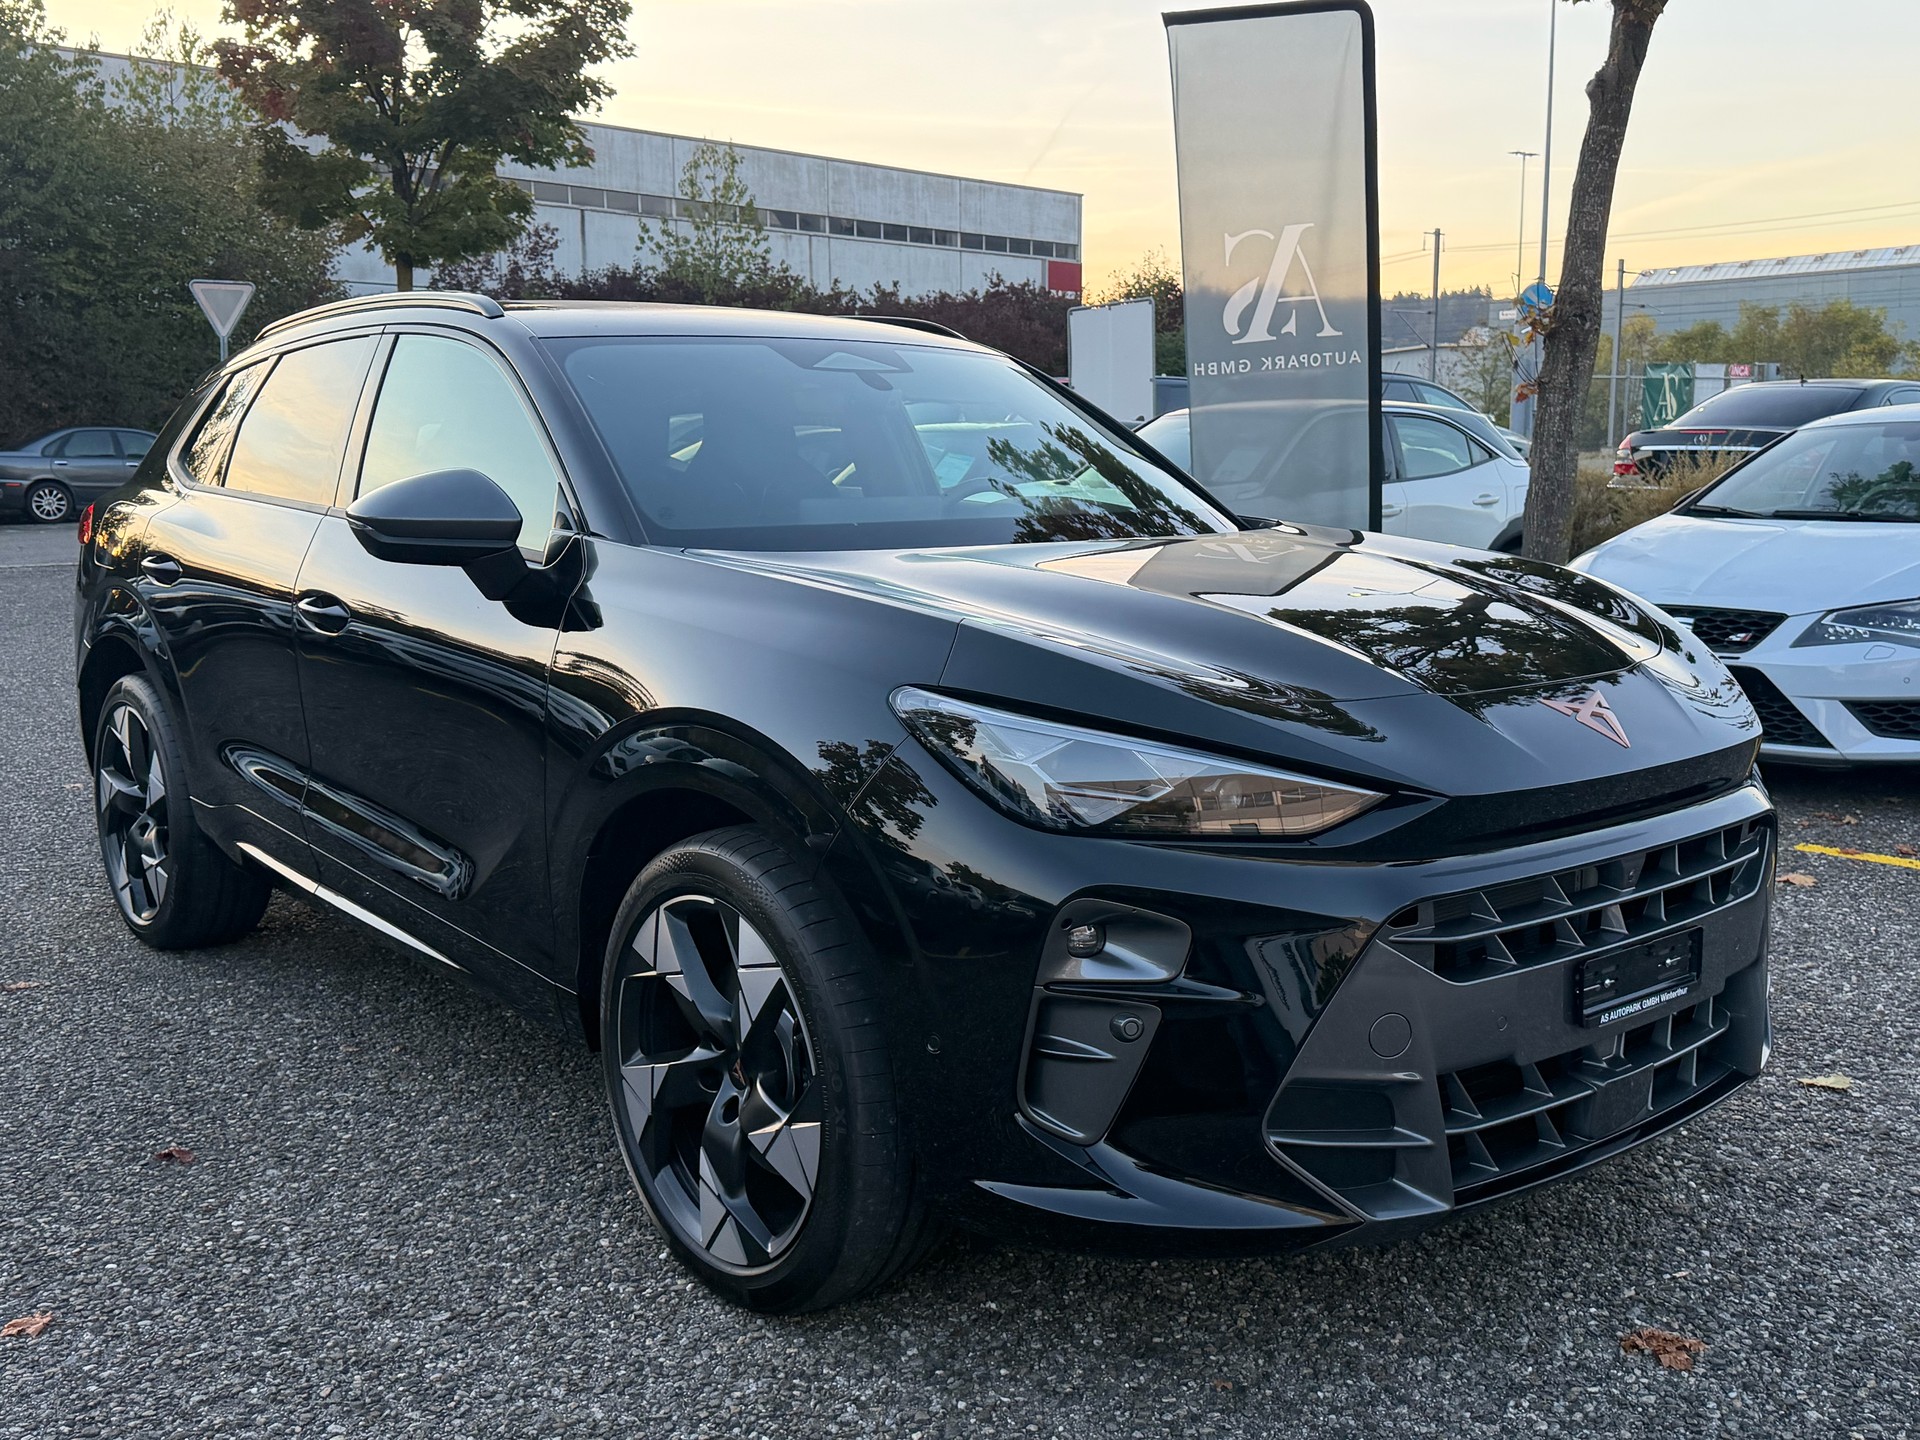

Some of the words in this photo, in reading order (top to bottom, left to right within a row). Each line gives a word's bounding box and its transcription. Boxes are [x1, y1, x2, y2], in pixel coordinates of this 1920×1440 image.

[1600, 1013, 1609, 1024] AS
[1609, 1002, 1641, 1020] AUTOPARK
[1642, 995, 1660, 1009] GMBH
[1660, 986, 1688, 1002] Winterthur
